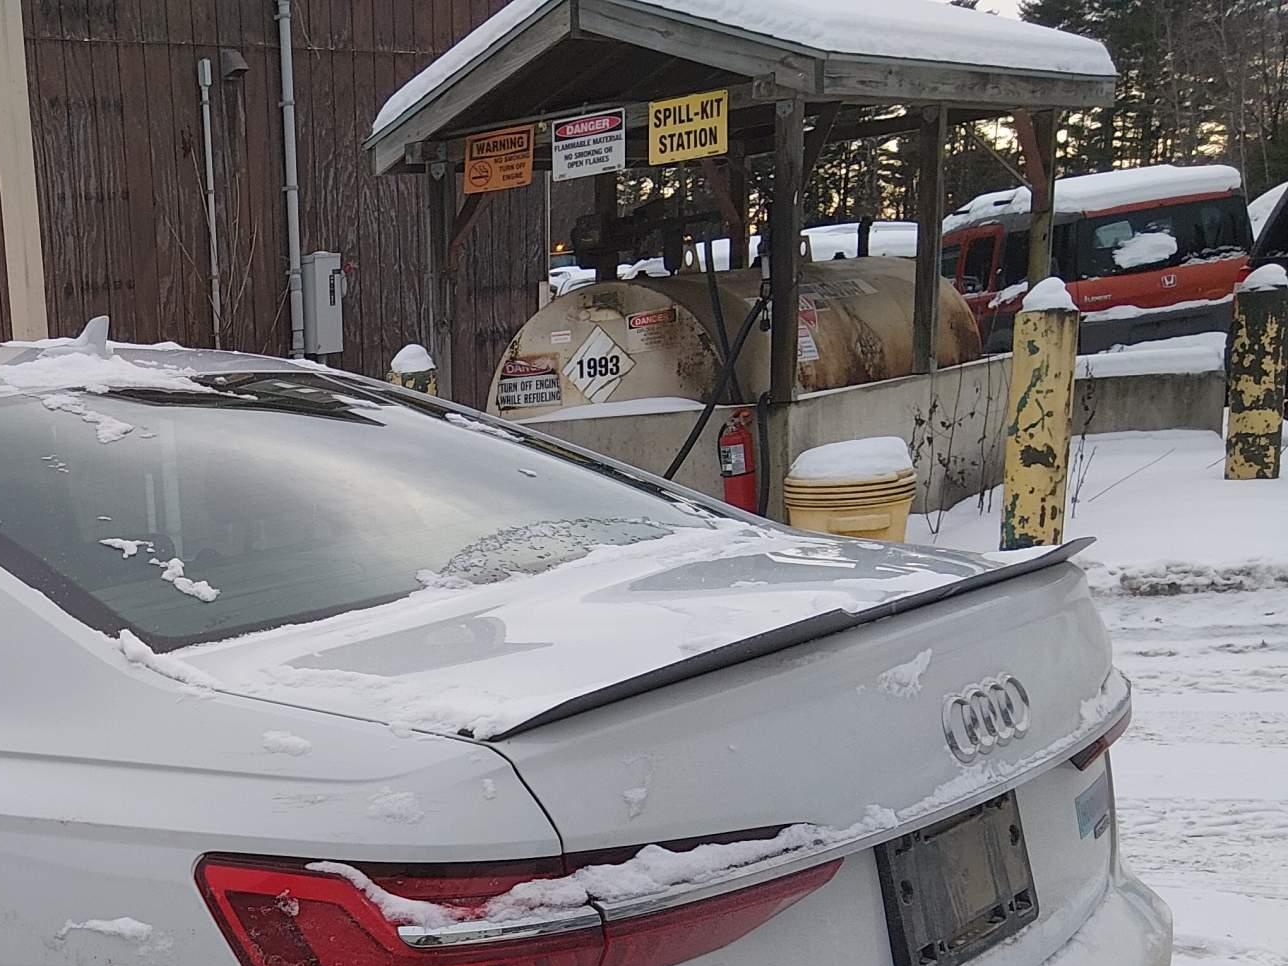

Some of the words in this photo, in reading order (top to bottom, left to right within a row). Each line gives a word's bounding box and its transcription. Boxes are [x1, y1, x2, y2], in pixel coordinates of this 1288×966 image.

[654, 98, 724, 128] SPILL-KIT
[566, 118, 610, 135] DANGER
[476, 136, 524, 155] WARNING
[554, 138, 592, 152] FLAMMABLE
[593, 133, 623, 145] MATERIAL
[659, 125, 718, 154] STATION
[567, 160, 584, 169] OPEN
[585, 155, 610, 166] FLAMES
[574, 148, 603, 159] SMOKING
[576, 355, 620, 379] 1993
[499, 382, 518, 393] TURN
[520, 380, 532, 391] OFF
[500, 394, 522, 405] WHILE
[524, 390, 561, 404] REFUELING
